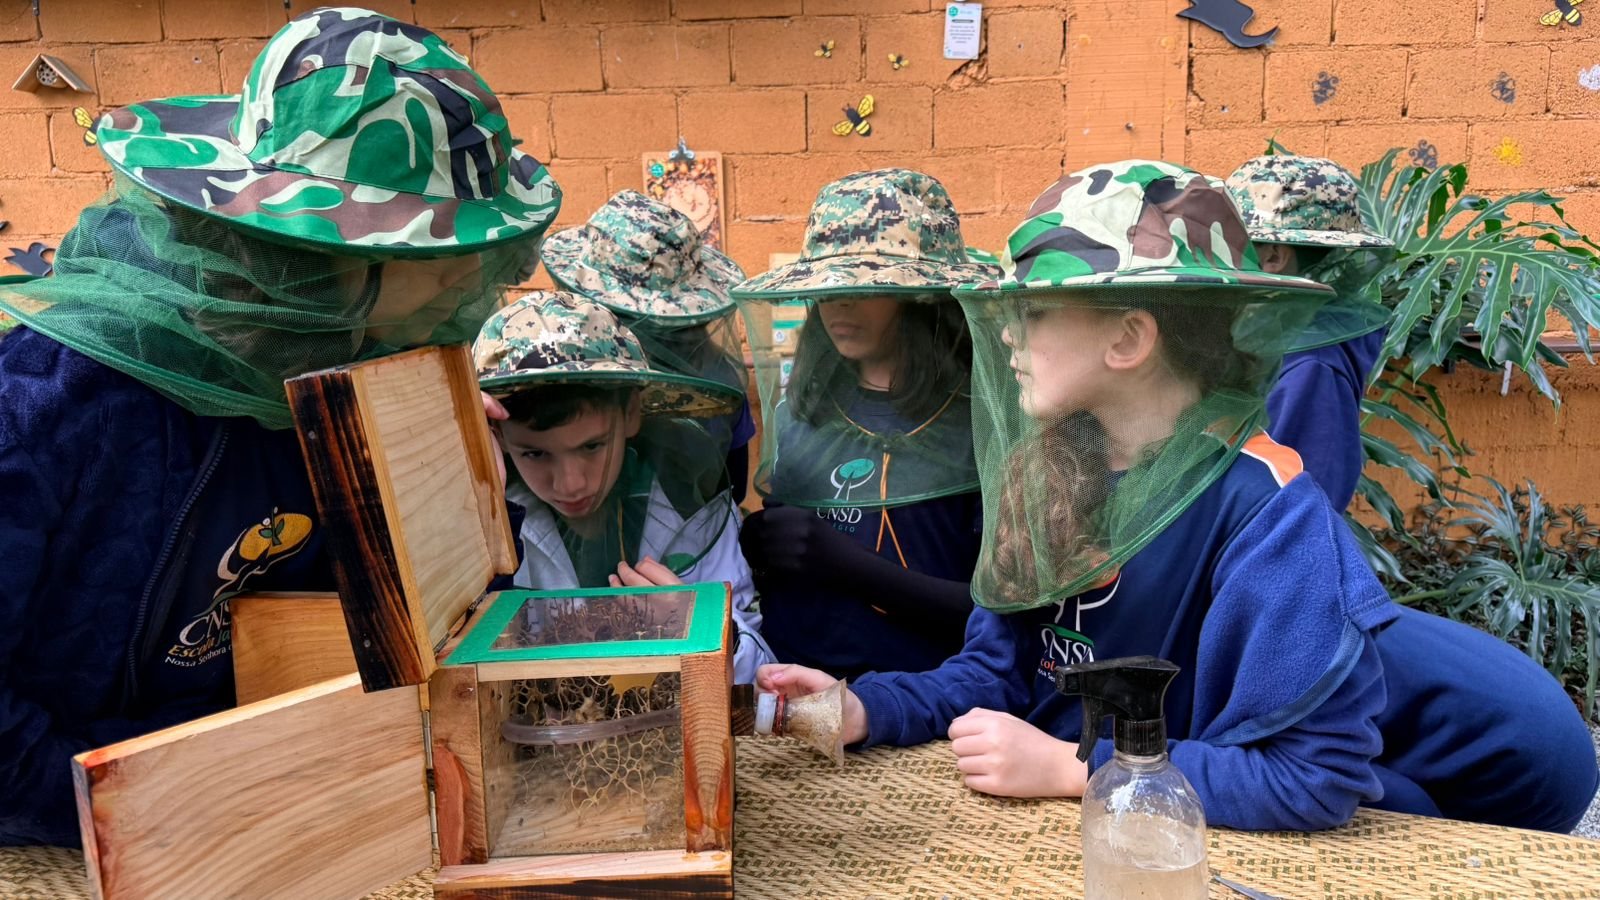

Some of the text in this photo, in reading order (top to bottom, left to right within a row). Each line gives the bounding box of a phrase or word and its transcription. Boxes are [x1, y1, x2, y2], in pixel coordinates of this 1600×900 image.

[816, 507, 862, 524] CNSD
[179, 599, 231, 646] CNS
[164, 656, 197, 667] Nossa
[198, 646, 227, 665] Senhora
